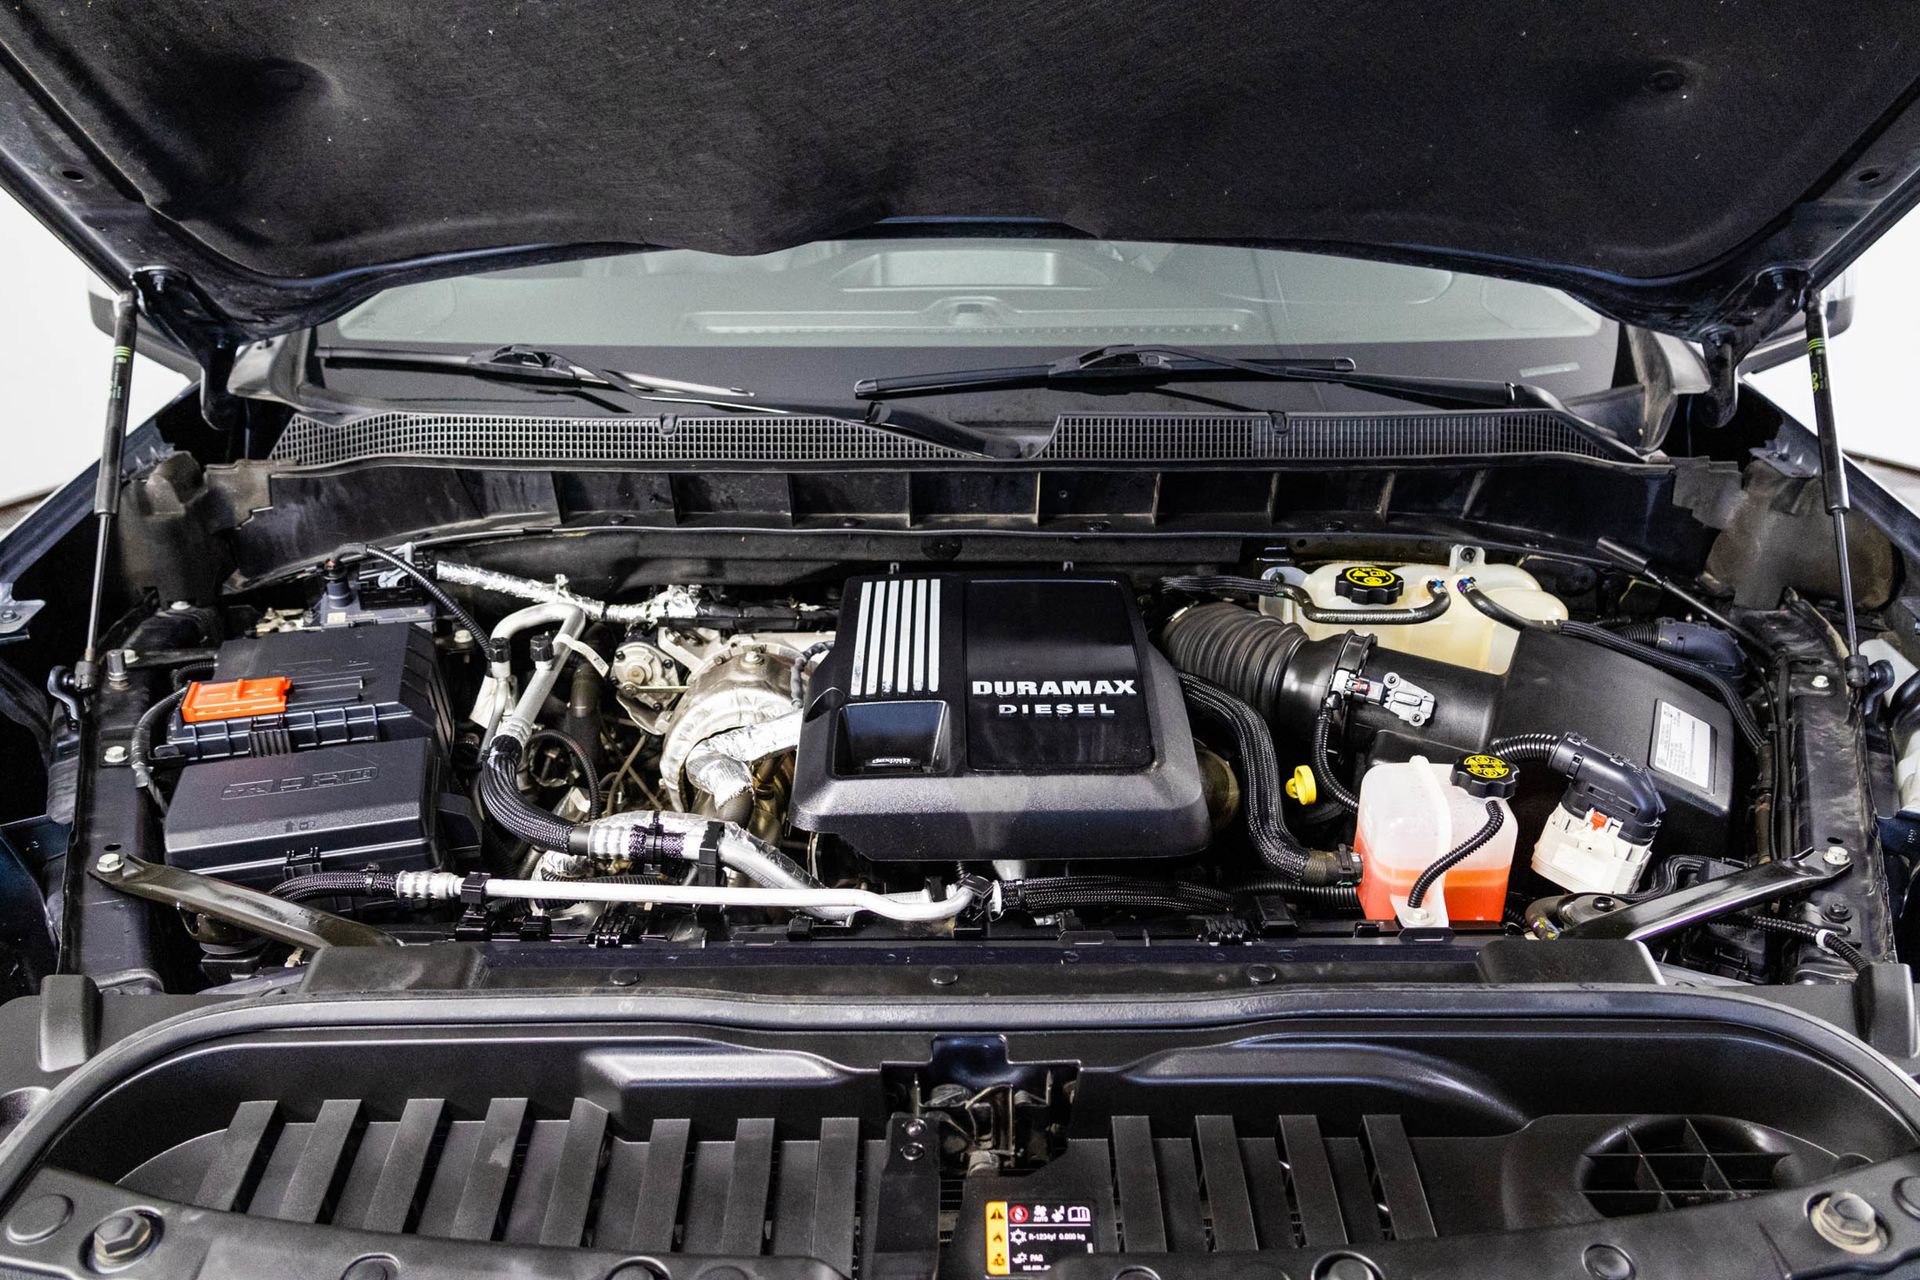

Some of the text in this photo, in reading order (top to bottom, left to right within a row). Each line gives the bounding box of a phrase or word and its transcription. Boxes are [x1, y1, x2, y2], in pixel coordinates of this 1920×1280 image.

[972, 680, 1137, 696] DURAMAX
[998, 703, 1116, 715] DIESEL
[1028, 1233, 1056, 1241] R-1234yf
[1077, 1233, 1086, 1241] kg
